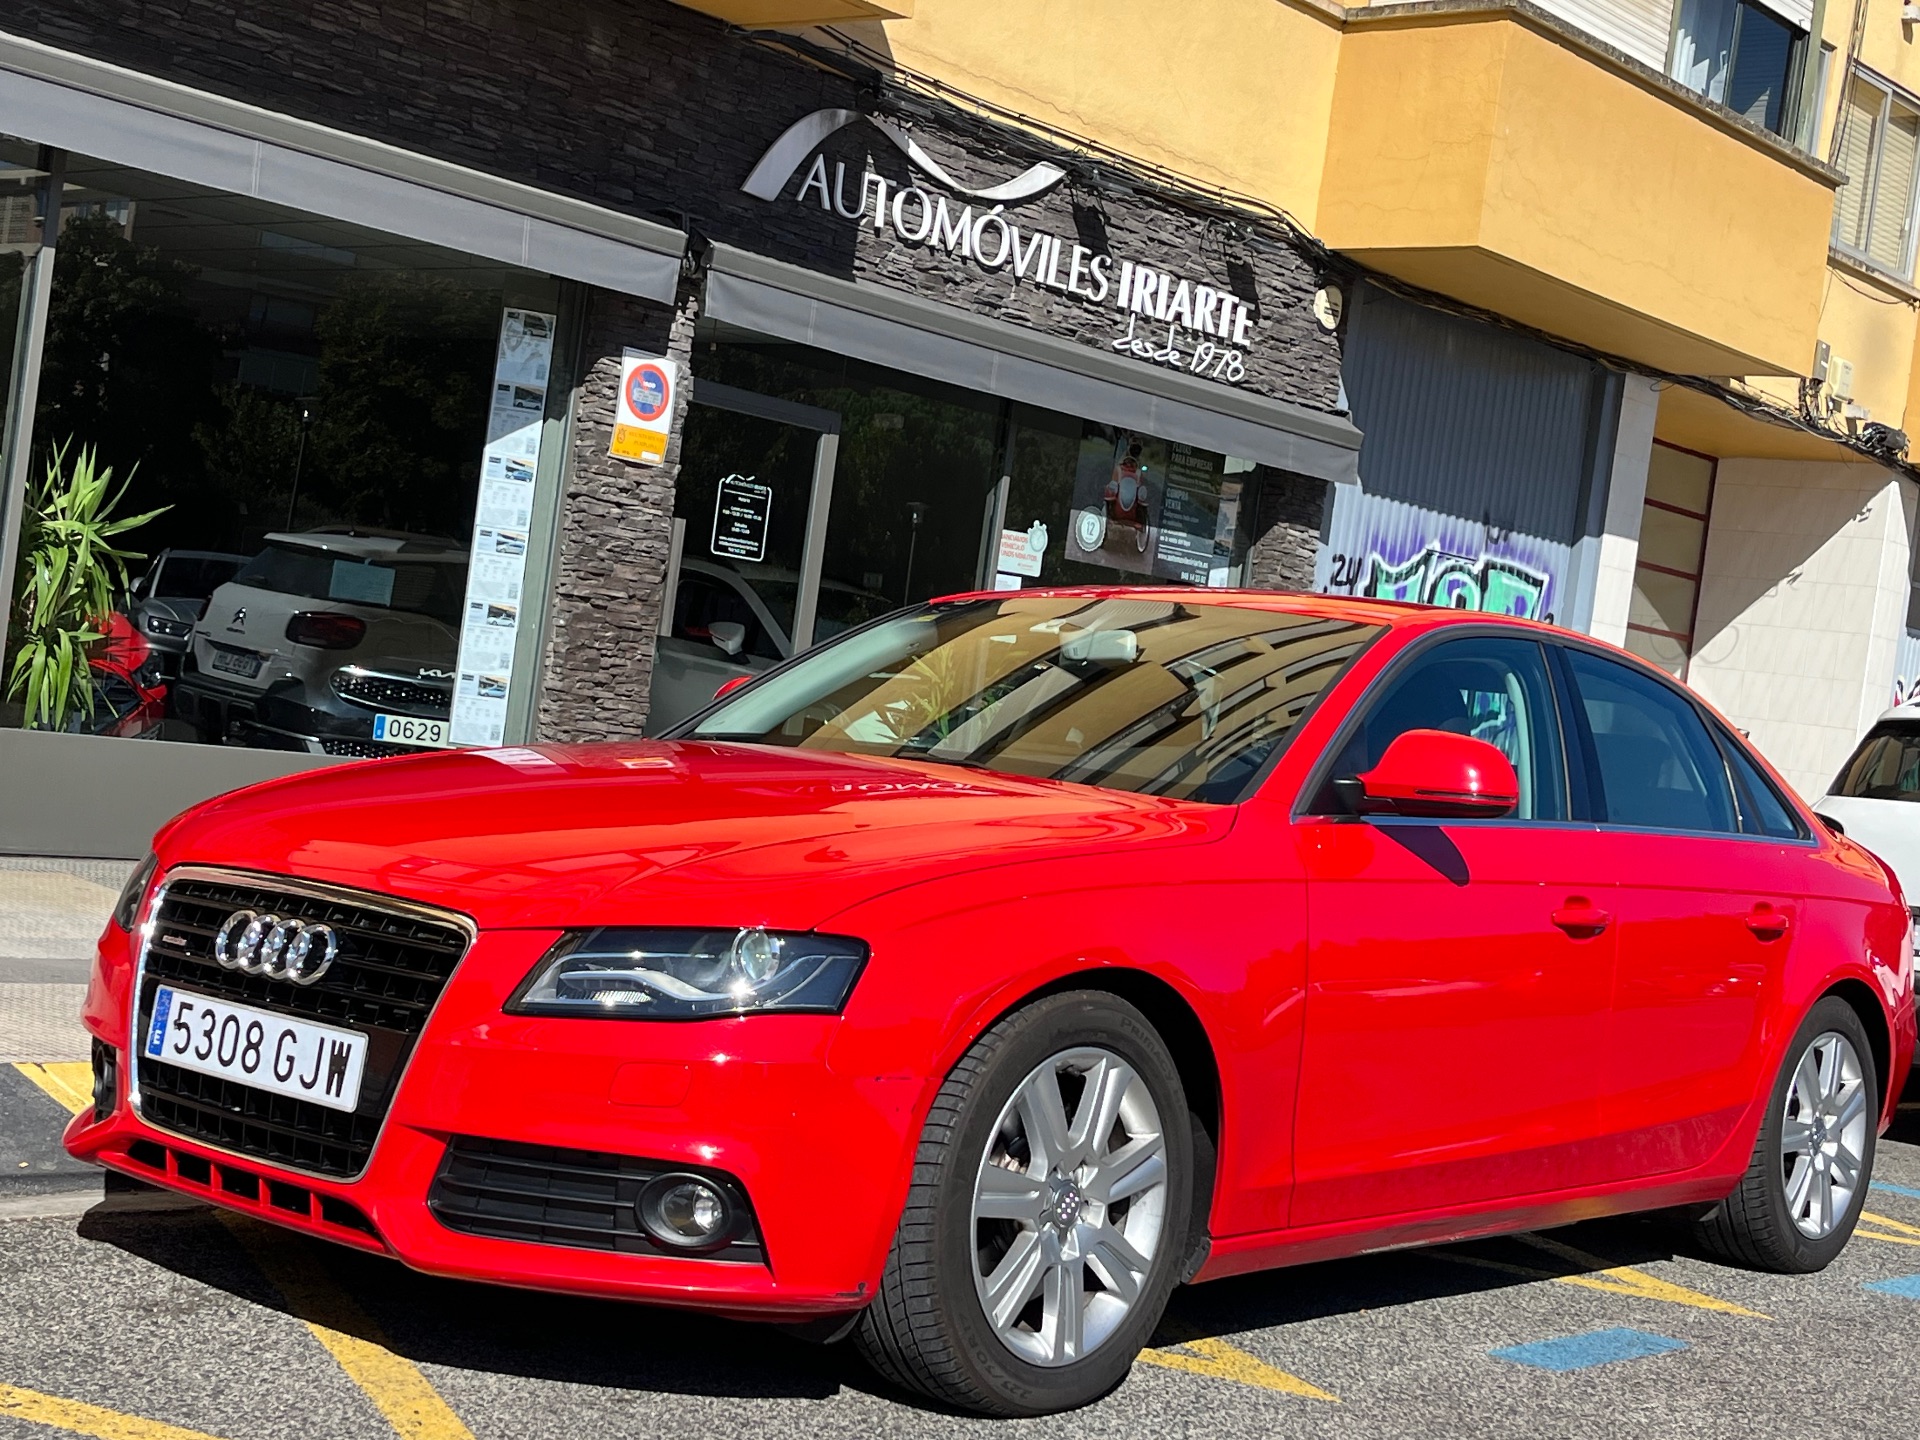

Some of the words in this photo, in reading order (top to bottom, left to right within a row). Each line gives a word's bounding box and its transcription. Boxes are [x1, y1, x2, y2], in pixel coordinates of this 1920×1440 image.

[796, 152, 1112, 302] AUTOMÓVILES
[1116, 260, 1256, 347] IRIARTE
[1111, 312, 1184, 367] desde
[1189, 342, 1245, 382] 1978
[1086, 520, 1096, 536] 12
[389, 719, 442, 743] 0629
[173, 1001, 265, 1075] 5308
[273, 1028, 352, 1098] GJW
